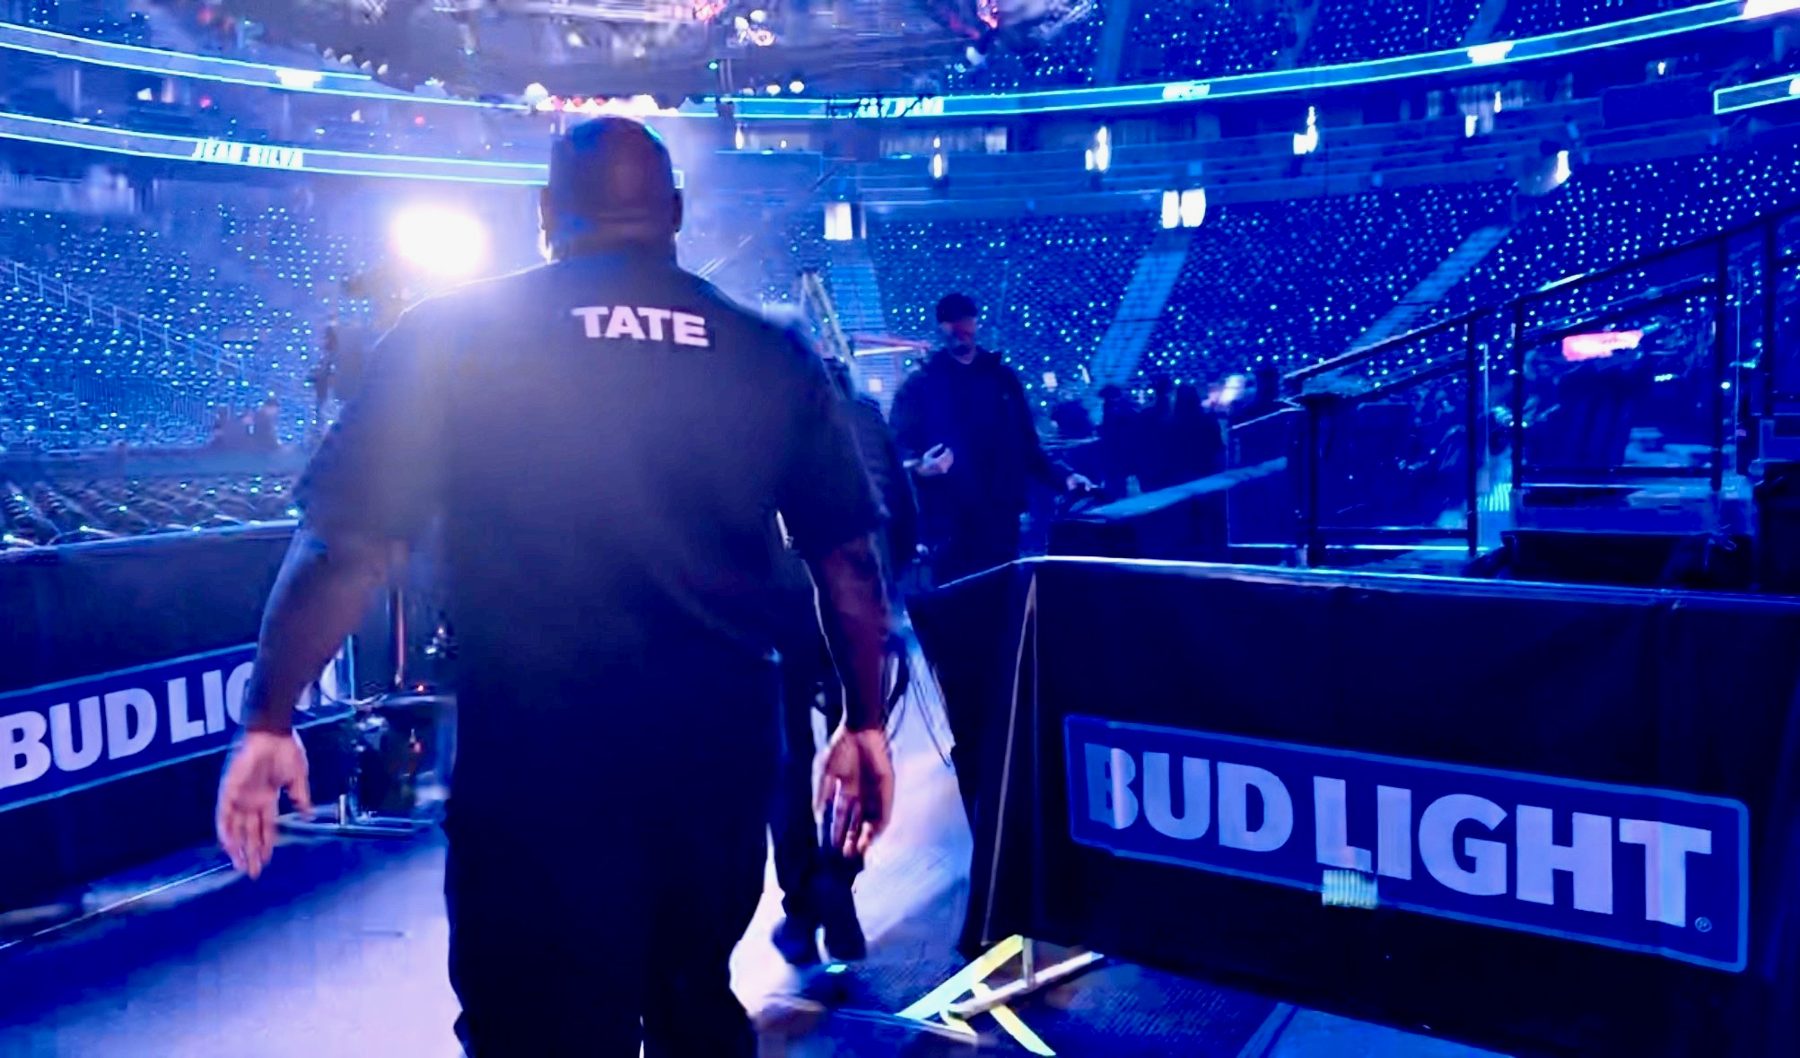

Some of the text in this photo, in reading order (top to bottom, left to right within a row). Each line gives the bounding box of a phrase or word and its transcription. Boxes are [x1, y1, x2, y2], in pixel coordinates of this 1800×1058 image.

[571, 305, 709, 347] TATE
[0, 687, 156, 789] BUD
[1085, 743, 1712, 928] BUD LIGHT
